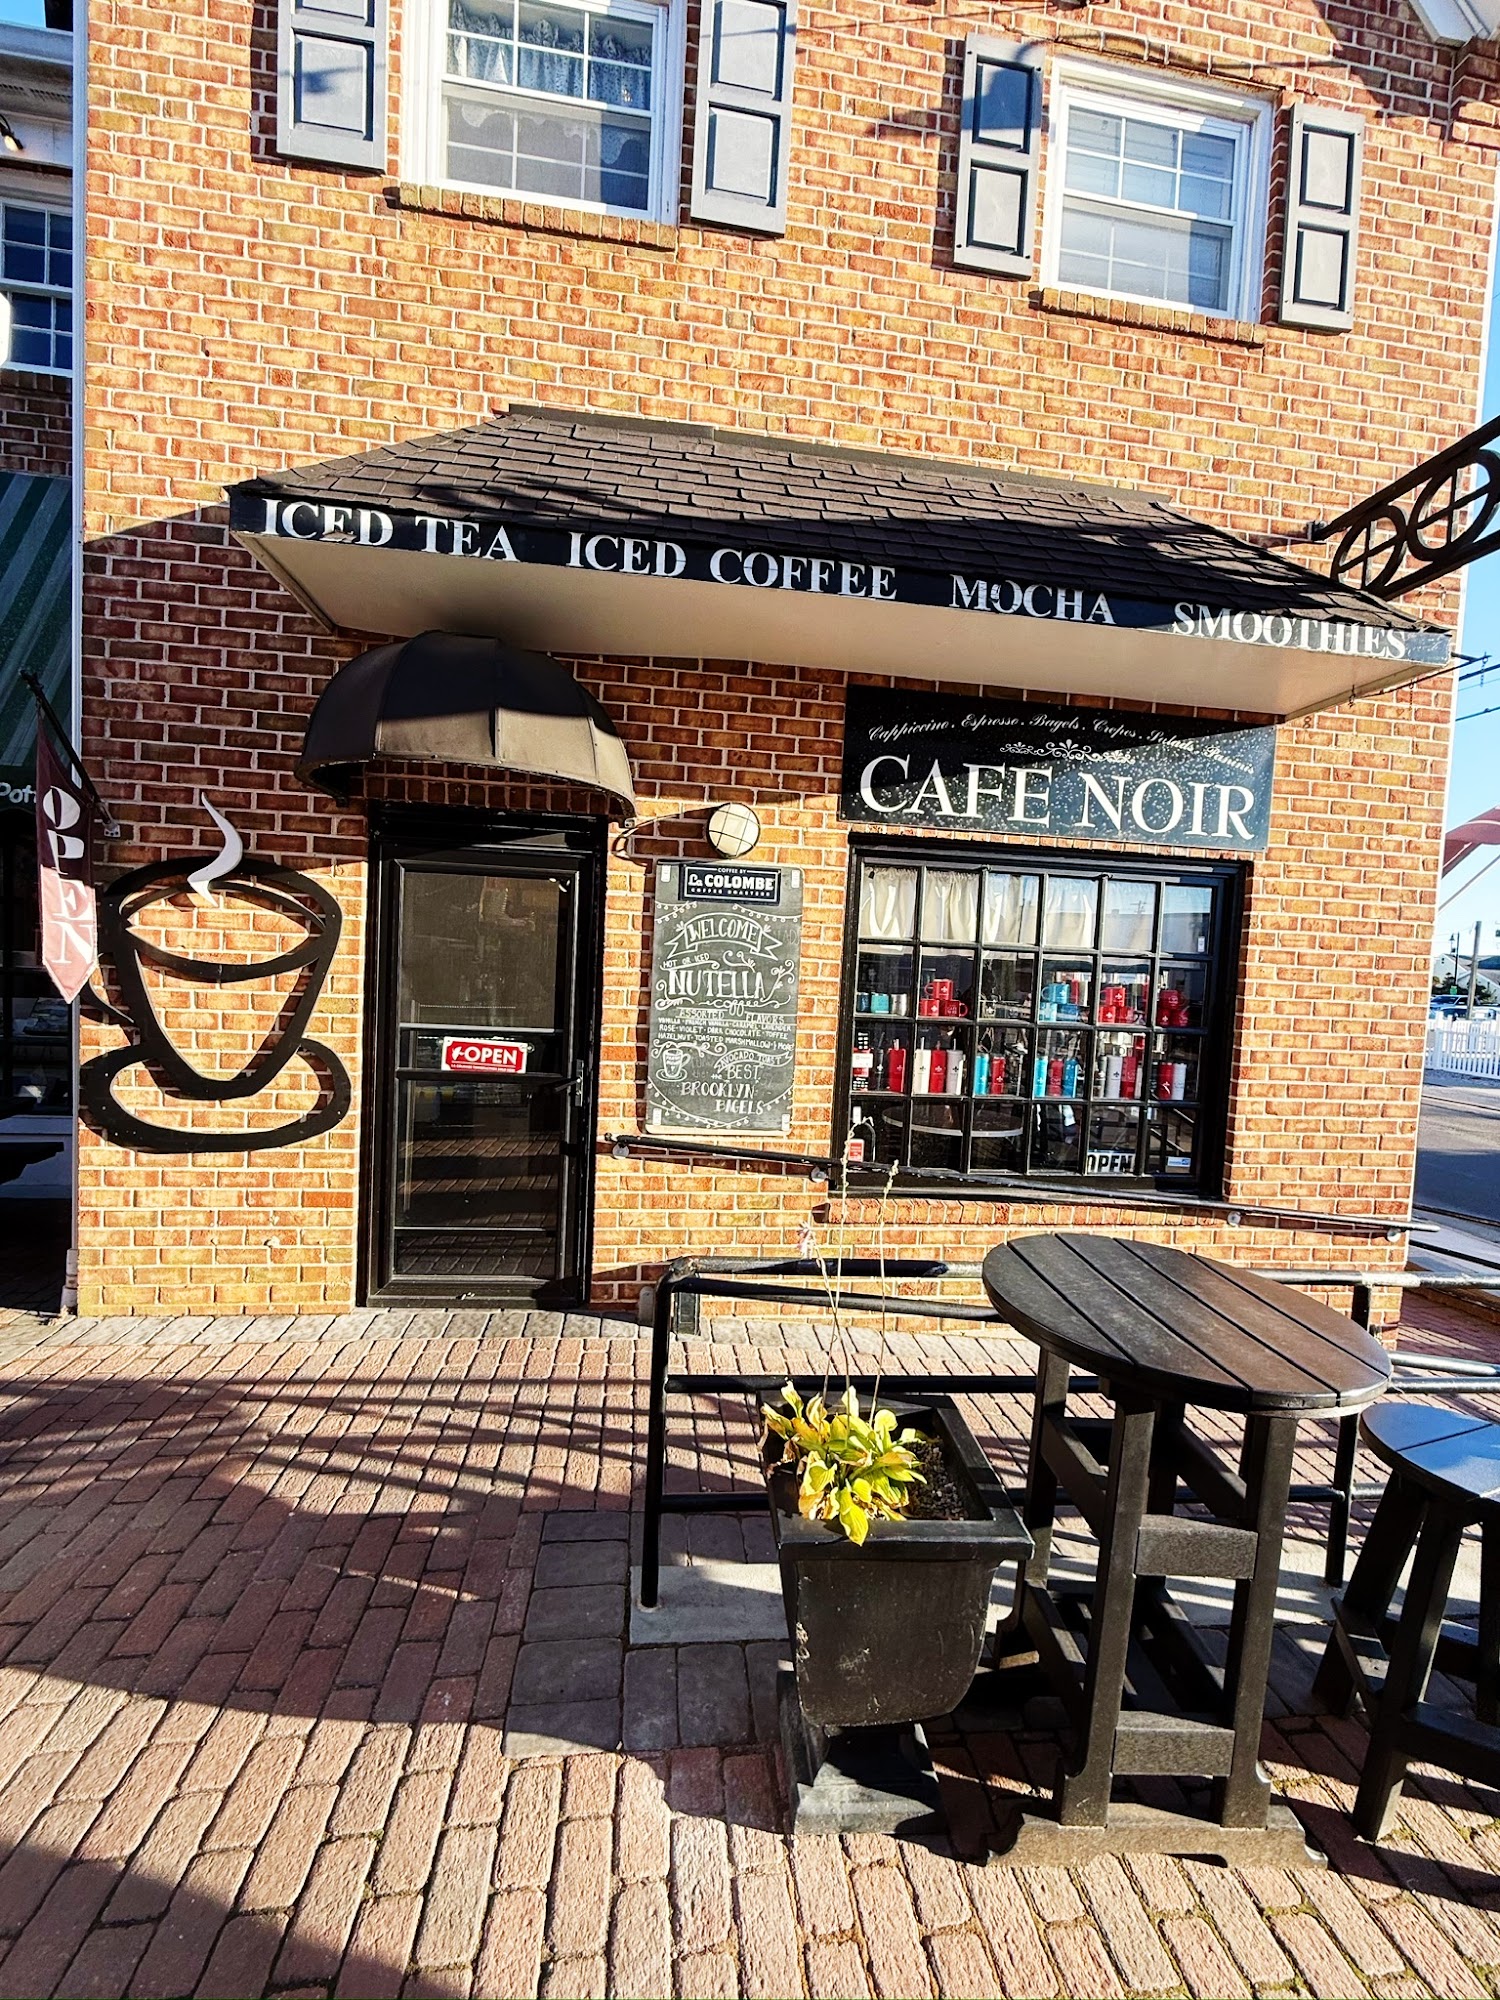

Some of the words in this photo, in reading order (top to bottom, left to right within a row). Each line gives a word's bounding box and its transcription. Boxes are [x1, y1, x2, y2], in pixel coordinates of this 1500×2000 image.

[262, 499, 394, 546] ICED
[415, 517, 519, 562] TEA
[567, 531, 687, 577] ICED
[709, 548, 898, 600] COFFEE
[949, 574, 1117, 625] MOCHA
[1172, 601, 1408, 660] SMOOTHIES
[961, 713, 1020, 731] Espresso
[1029, 713, 1080, 733] Bagels
[1093, 719, 1136, 738] Crepes
[859, 753, 1054, 825] CAFE
[1075, 772, 1256, 840] NOIR
[43, 786, 93, 964] OPEN
[688, 874, 703, 887] La
[704, 874, 774, 891] COLOMBE
[687, 917, 758, 944] WELCOME
[663, 960, 677, 968] HOT
[682, 957, 692, 965] OR
[694, 953, 709, 963] ICED
[668, 970, 766, 999] NUTELLA
[680, 1010, 724, 1019] ASSORTED
[706, 999, 766, 1017] coffee
[746, 1013, 785, 1024] FLAVORS
[659, 1024, 676, 1032] ROSE
[725, 1028, 761, 1038] CHOCOLATE
[765, 1031, 789, 1039] TOFFEE
[725, 1037, 771, 1048] MARSHMALLOW
[464, 1046, 517, 1065] OPEN
[720, 1050, 754, 1067] AVOCADO
[757, 1054, 781, 1065] TOAST
[727, 1064, 760, 1080] BEST
[681, 1081, 755, 1099] BROOKLYN
[714, 1100, 764, 1115] BAGELS
[1088, 1154, 1133, 1173] OPEN
